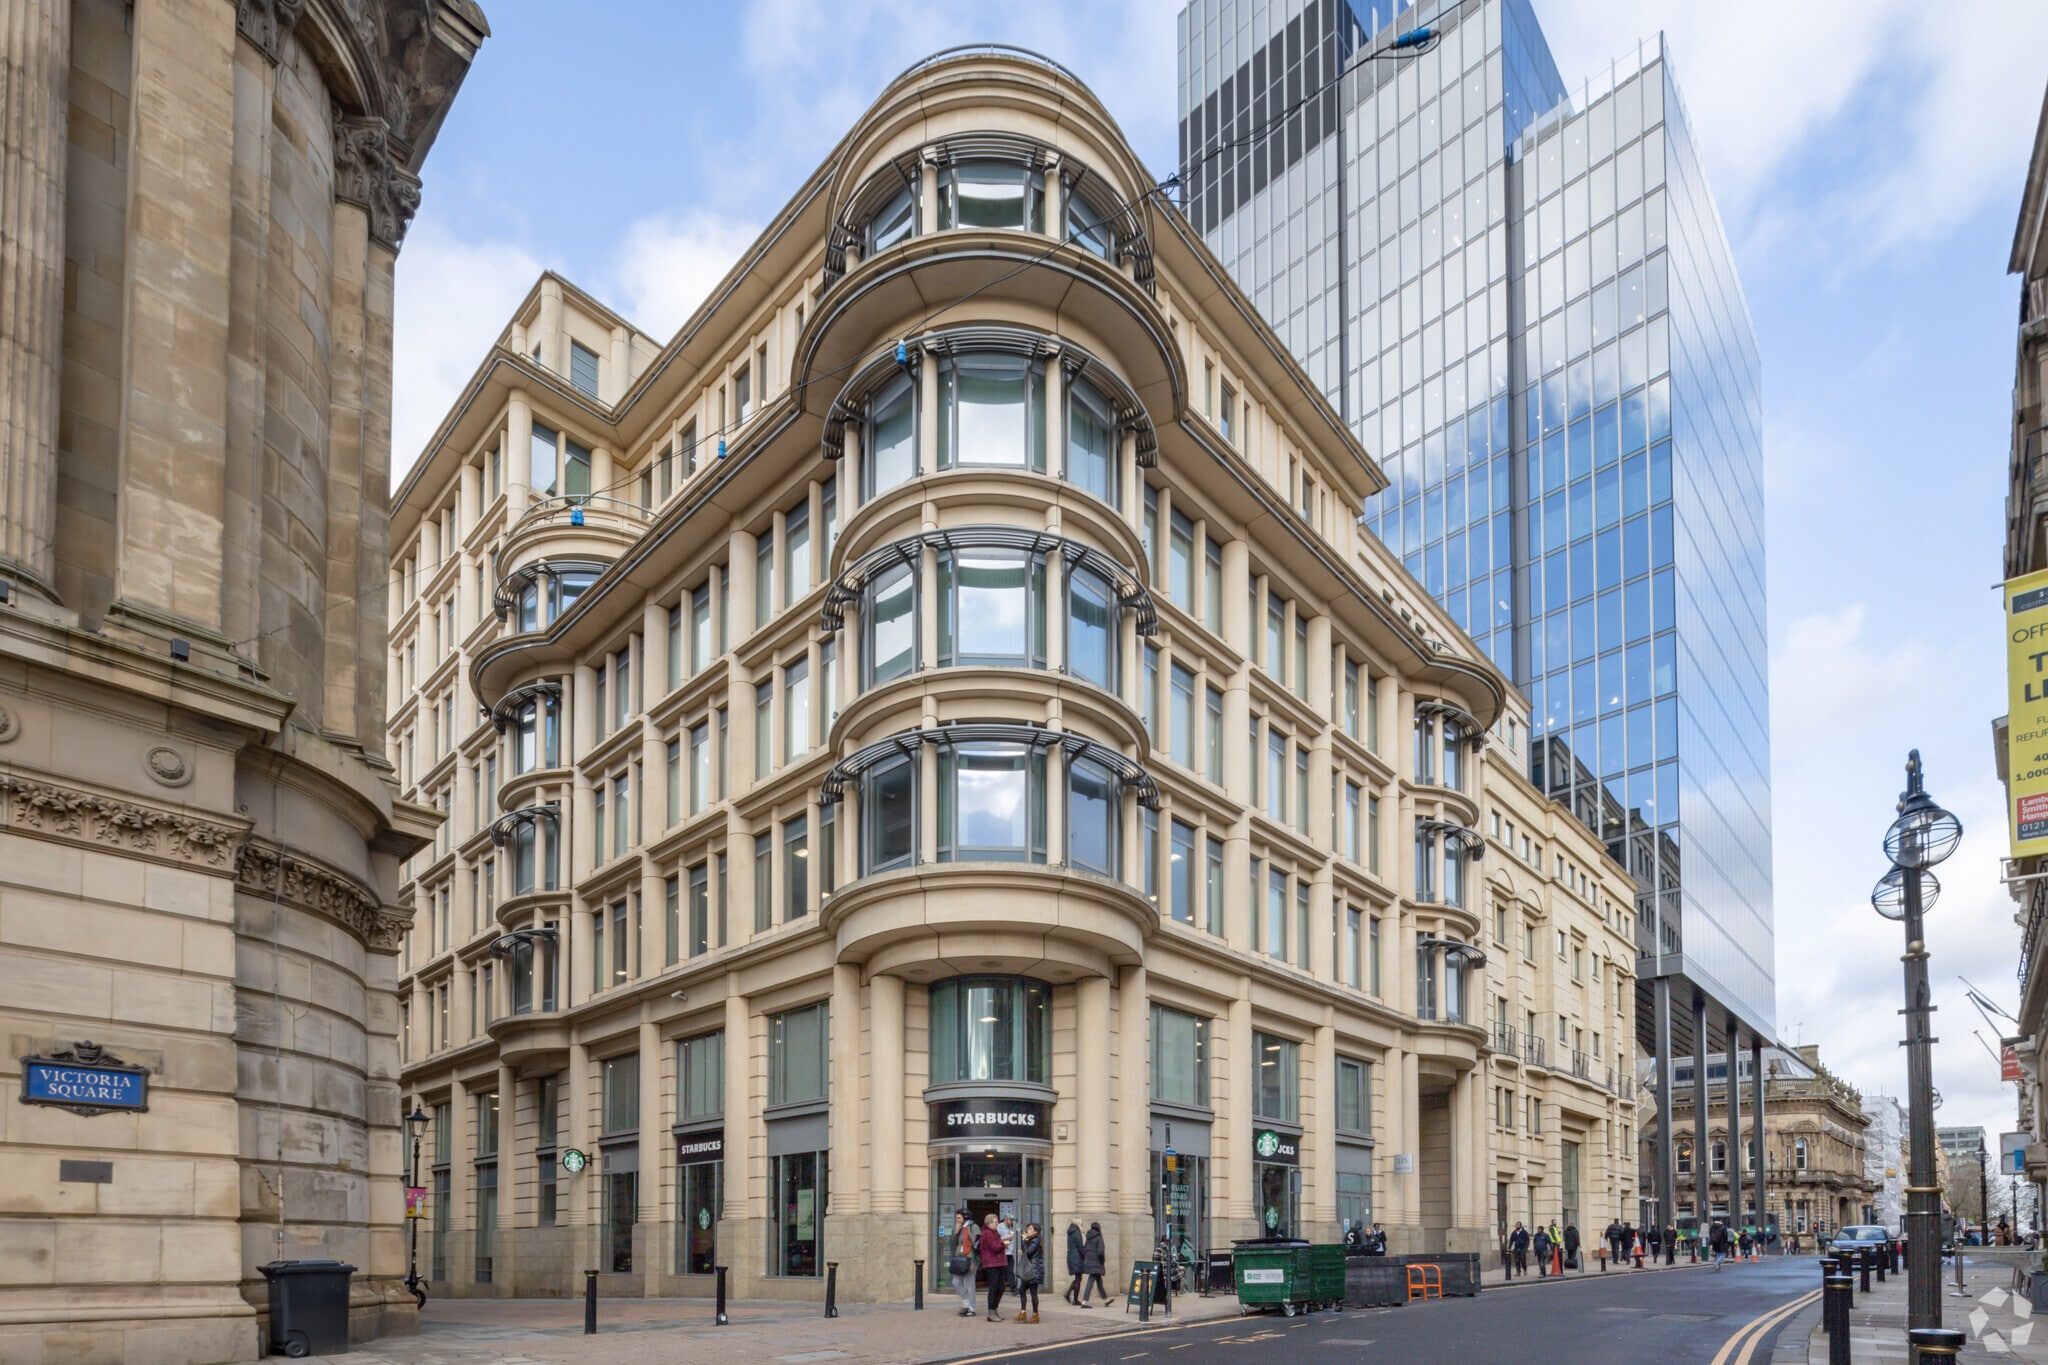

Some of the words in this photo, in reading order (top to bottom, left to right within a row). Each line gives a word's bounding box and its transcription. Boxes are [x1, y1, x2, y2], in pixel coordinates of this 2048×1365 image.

[40, 1069, 131, 1088] VICTORIA
[48, 1083, 122, 1100] SQUARE
[947, 1112, 1035, 1126] STARBUCKS
[681, 1140, 721, 1154] STARBUCKS
